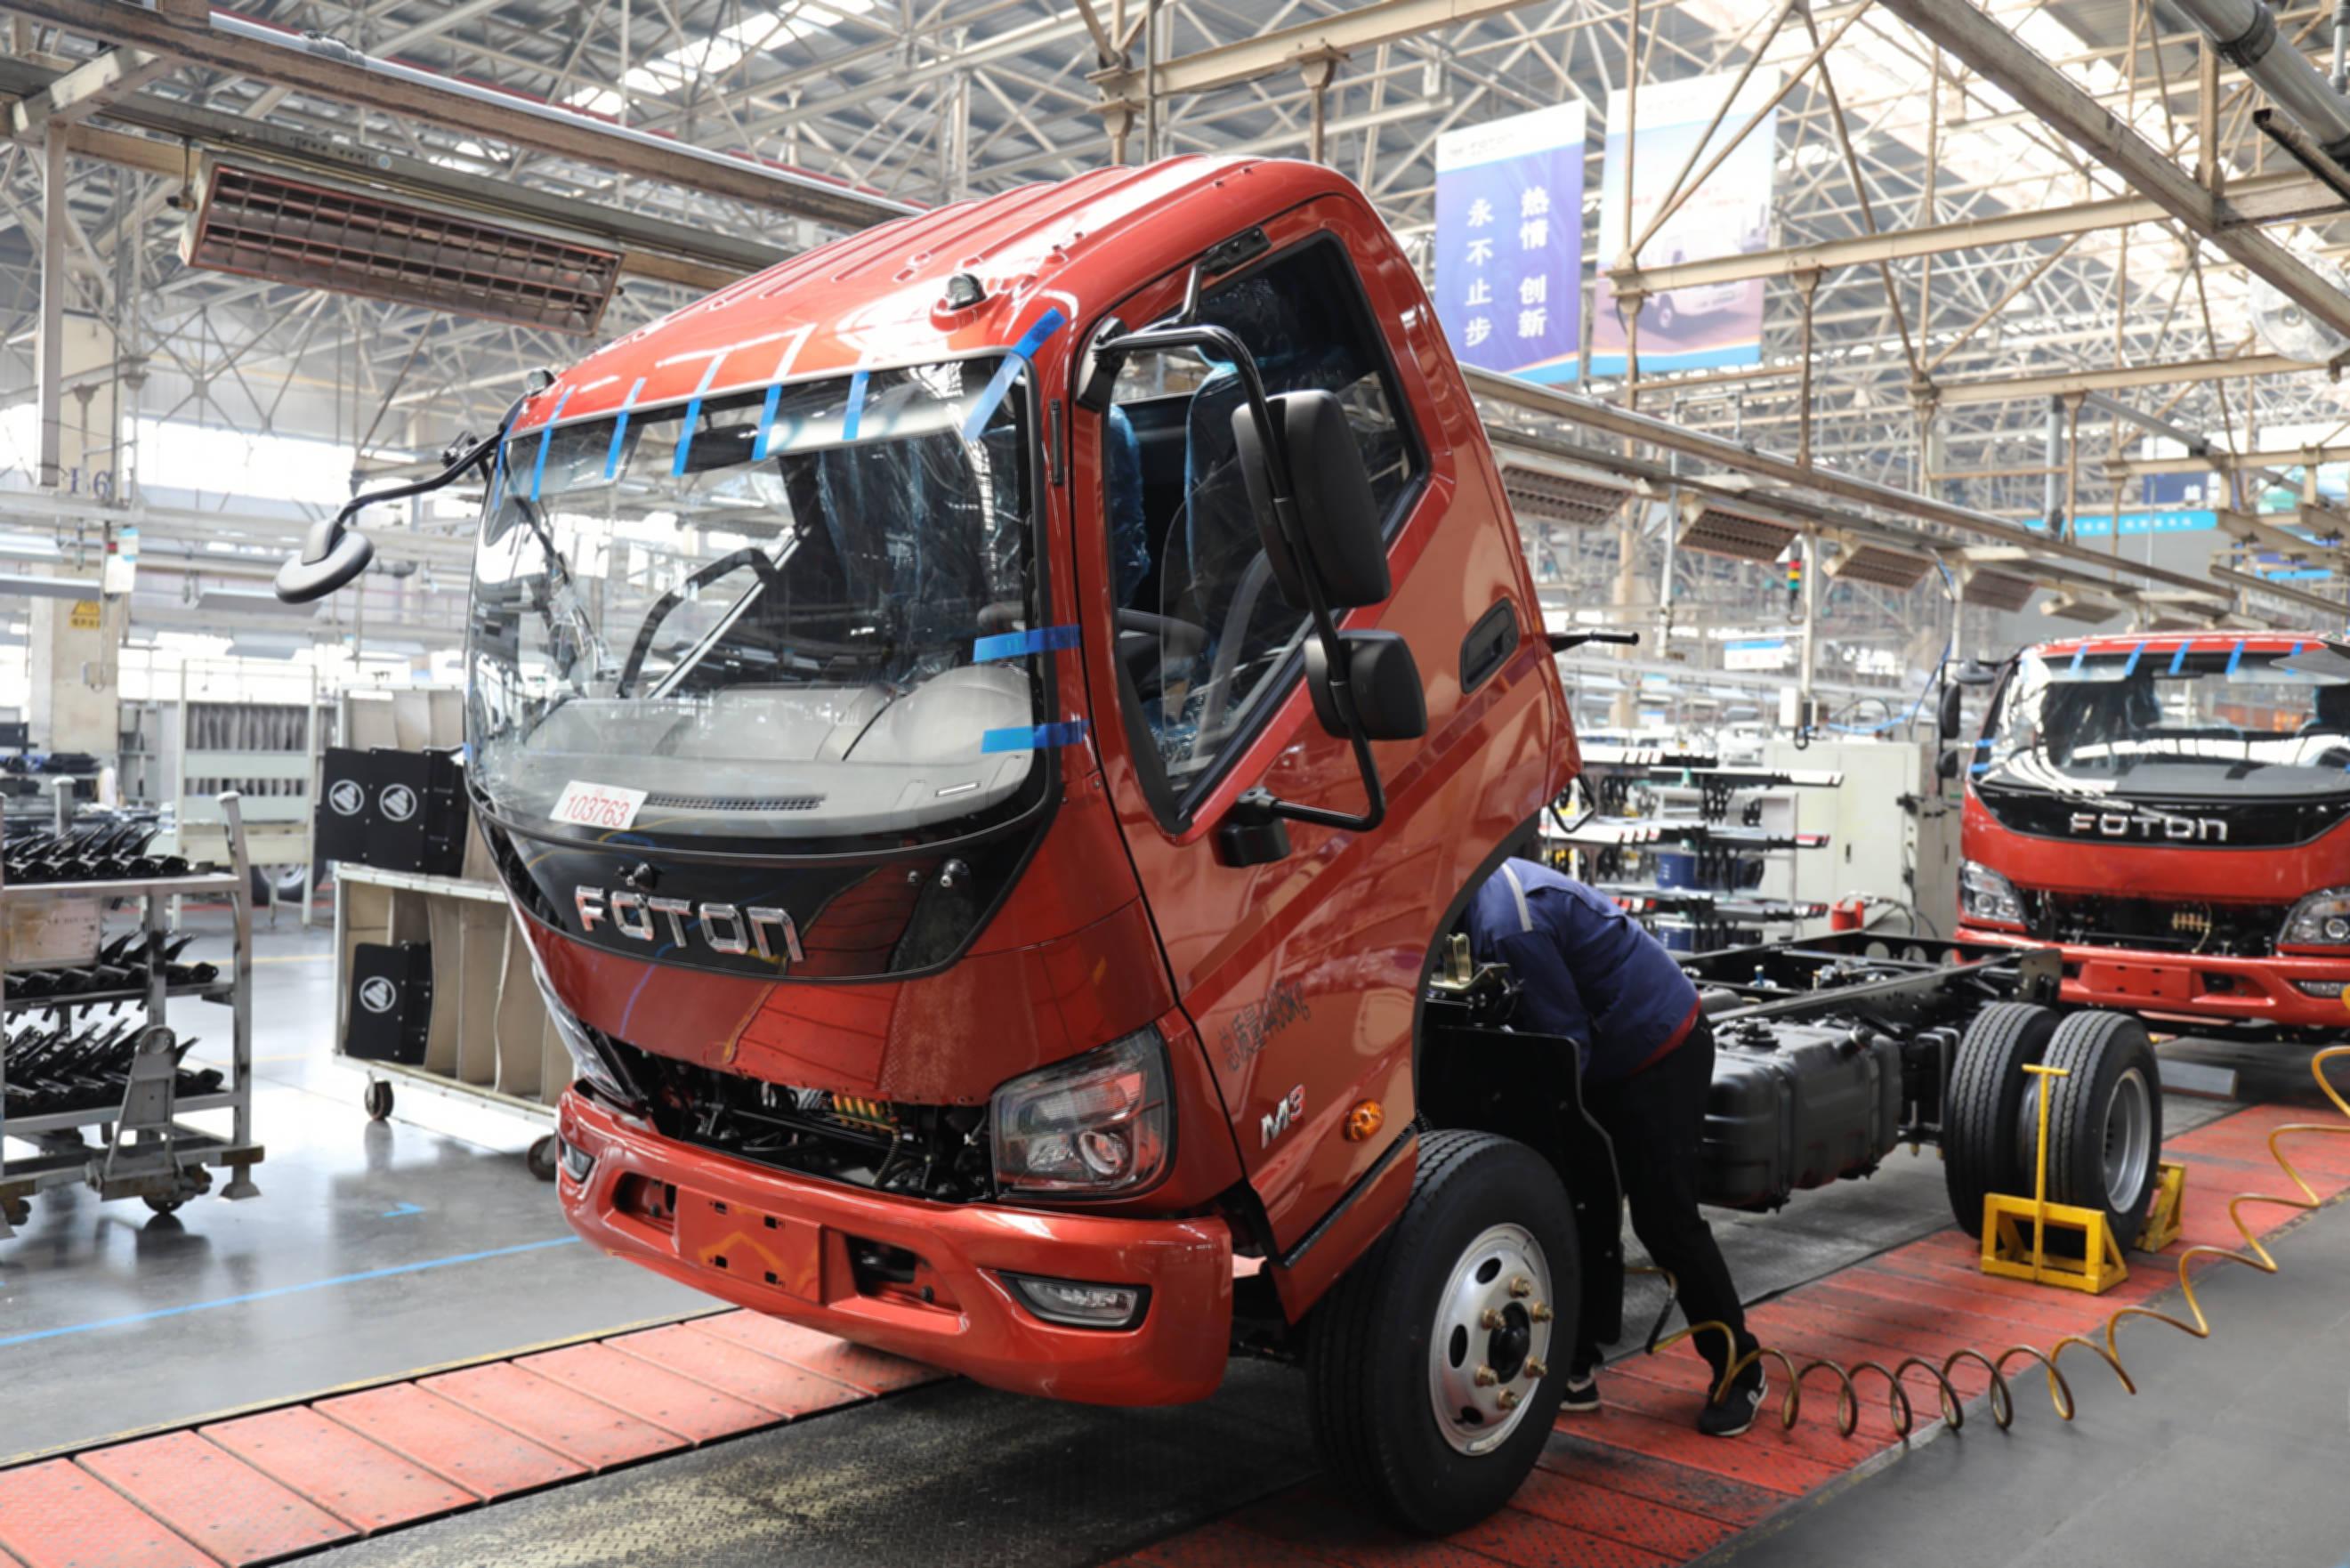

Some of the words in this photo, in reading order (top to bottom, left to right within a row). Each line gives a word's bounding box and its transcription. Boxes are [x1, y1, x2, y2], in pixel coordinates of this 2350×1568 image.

[1519, 185, 1551, 250] 热情
[1464, 198, 1495, 348] 永不止步
[1517, 273, 1548, 339] 创新
[563, 793, 631, 828] 103763
[2069, 811, 2229, 842] FOTON
[574, 885, 805, 963] FOTON
[1259, 1083, 1306, 1150] M3
